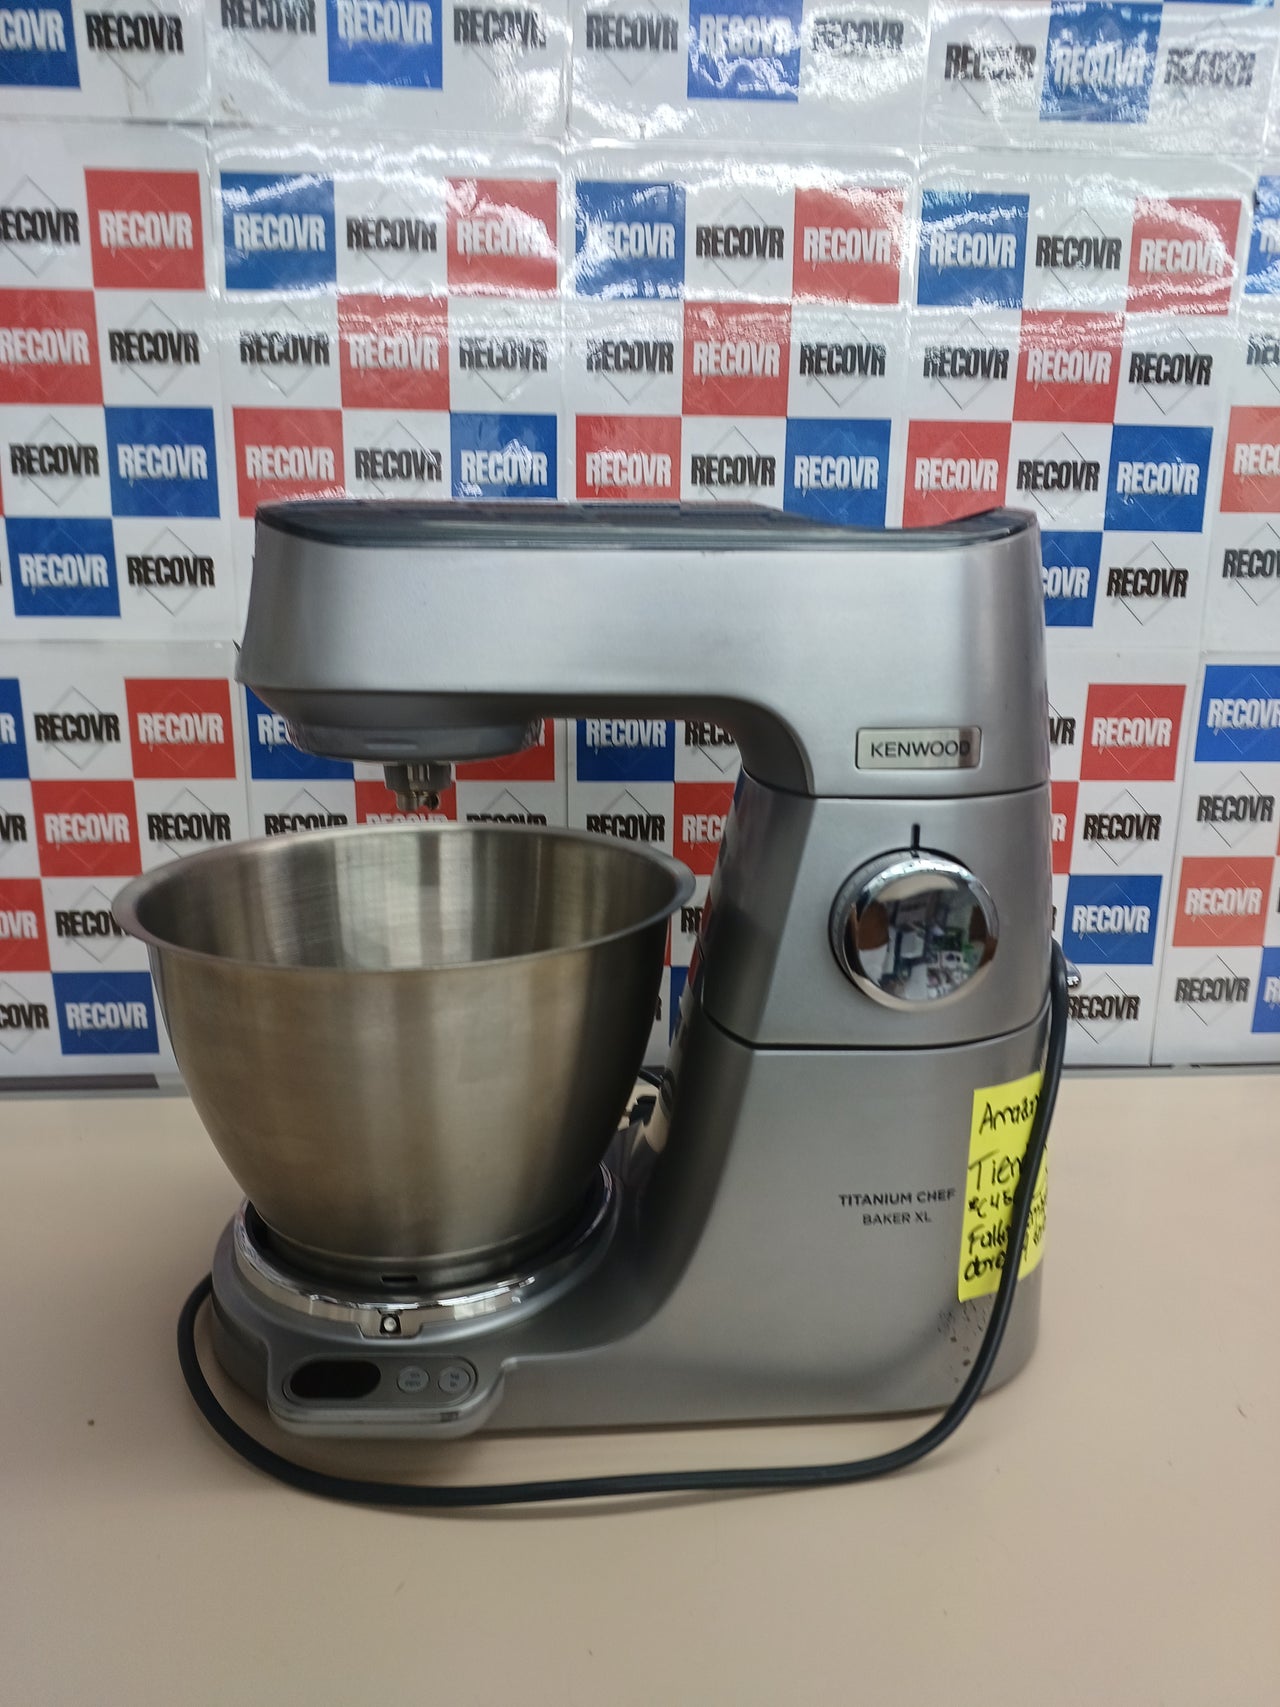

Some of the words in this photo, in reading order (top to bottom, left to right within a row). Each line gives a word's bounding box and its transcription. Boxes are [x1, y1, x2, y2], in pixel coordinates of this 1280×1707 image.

[0, 8, 66, 53] COVR
[85, 12, 184, 54] RECOVR
[337, 0, 433, 45] RECOVR
[453, 5, 547, 50] RECOVR
[586, 12, 678, 53] RECOVR
[0, 208, 80, 245] ECOVR
[99, 210, 194, 250] RECOVR
[233, 213, 327, 252] RECOVR
[346, 216, 438, 252] RECOVR
[588, 221, 676, 259] ECOVR
[696, 226, 784, 261] RECOVR
[803, 226, 891, 265] RECOVR
[929, 232, 1017, 269] RECOVR
[1035, 236, 1122, 271] RECOVR
[1139, 238, 1226, 276] RECOVR
[0, 327, 91, 366] RECOVR
[109, 330, 200, 365] RECOVR
[240, 331, 330, 366] RECOVR
[349, 334, 441, 371] RECOVR
[459, 337, 548, 372] RECOVR
[586, 339, 674, 375] RECOVR
[693, 340, 781, 377] RECOVR
[800, 343, 886, 377] RECOVR
[923, 346, 1010, 380] RECOVR
[1026, 349, 1112, 385] RECOVR
[1129, 352, 1213, 386] RECOVR
[10, 443, 99, 477] RECOVR
[117, 444, 209, 481] RECOVR
[245, 446, 335, 482] RECOVR
[355, 448, 442, 482] RECOVR
[460, 449, 548, 487] RECOVR
[585, 452, 672, 488] RECOVR
[691, 455, 776, 488] RECOVR
[794, 455, 879, 490] RECOVR
[914, 457, 999, 493] RECOVR
[1017, 461, 1101, 493] RECOVR
[1233, 443, 1280, 477] REC
[1116, 462, 1200, 496] RECOVR
[20, 553, 109, 588] RECOVR
[127, 556, 215, 588] RECOVR
[1222, 549, 1280, 579] RECO
[1041, 565, 1090, 599] COVR
[1107, 567, 1189, 599] RECOVR
[33, 713, 121, 743] RECOVR
[137, 713, 225, 745] RECOVR
[1207, 698, 1280, 730] RECOVR
[586, 719, 667, 747] RECOVR
[685, 720, 736, 746] REC
[871, 741, 970, 757] KENWOOD
[1091, 717, 1173, 747] RECOVR
[1197, 795, 1275, 822] RECOVR
[44, 813, 131, 844] RECOVR
[147, 814, 232, 841] RECOVR
[586, 815, 665, 841] RECOVR
[682, 814, 727, 843] REC
[1083, 814, 1162, 841] RECOVR
[1184, 887, 1263, 916] RECOVR
[0, 910, 38, 939] OVR
[55, 910, 130, 937] RECO
[1072, 905, 1151, 933] RECOVR
[1174, 978, 1250, 1002] RECOVR
[0, 1003, 49, 1028] COVR
[65, 1002, 148, 1030] RECOVR
[839, 1192, 912, 1207] TITANIUM
[916, 1188, 956, 1204] CHEF
[862, 1212, 911, 1226] BAKER
[914, 1210, 932, 1223] XL
